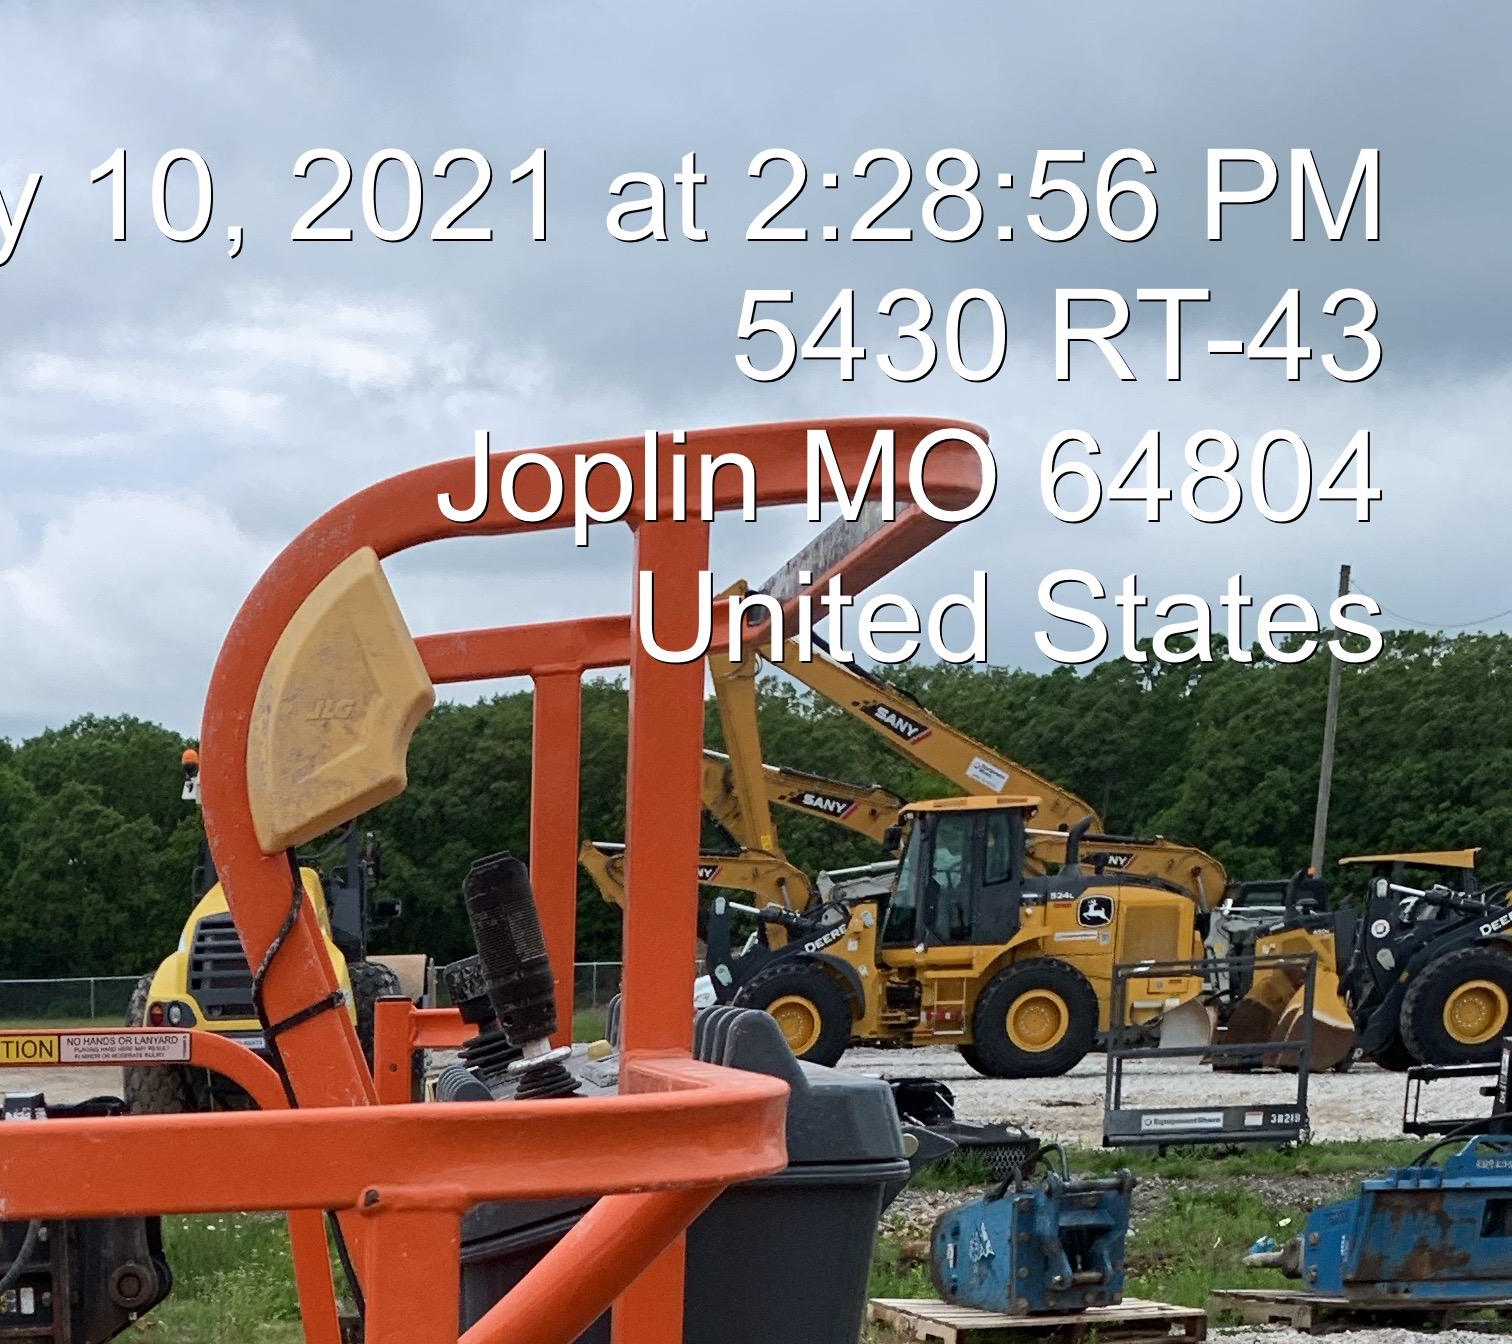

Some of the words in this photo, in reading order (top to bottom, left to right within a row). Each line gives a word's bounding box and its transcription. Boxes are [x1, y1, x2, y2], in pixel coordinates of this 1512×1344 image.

[304, 698, 356, 722] JLG
[874, 706, 920, 738] SANY
[802, 793, 847, 814] SANY
[1479, 911, 1512, 936] DEE
[804, 923, 847, 953] DEERE
[67, 1038, 81, 1046] NO
[83, 1037, 116, 1046] HANDS
[118, 1037, 133, 1045] OR
[134, 1035, 178, 1045] LANYARD
